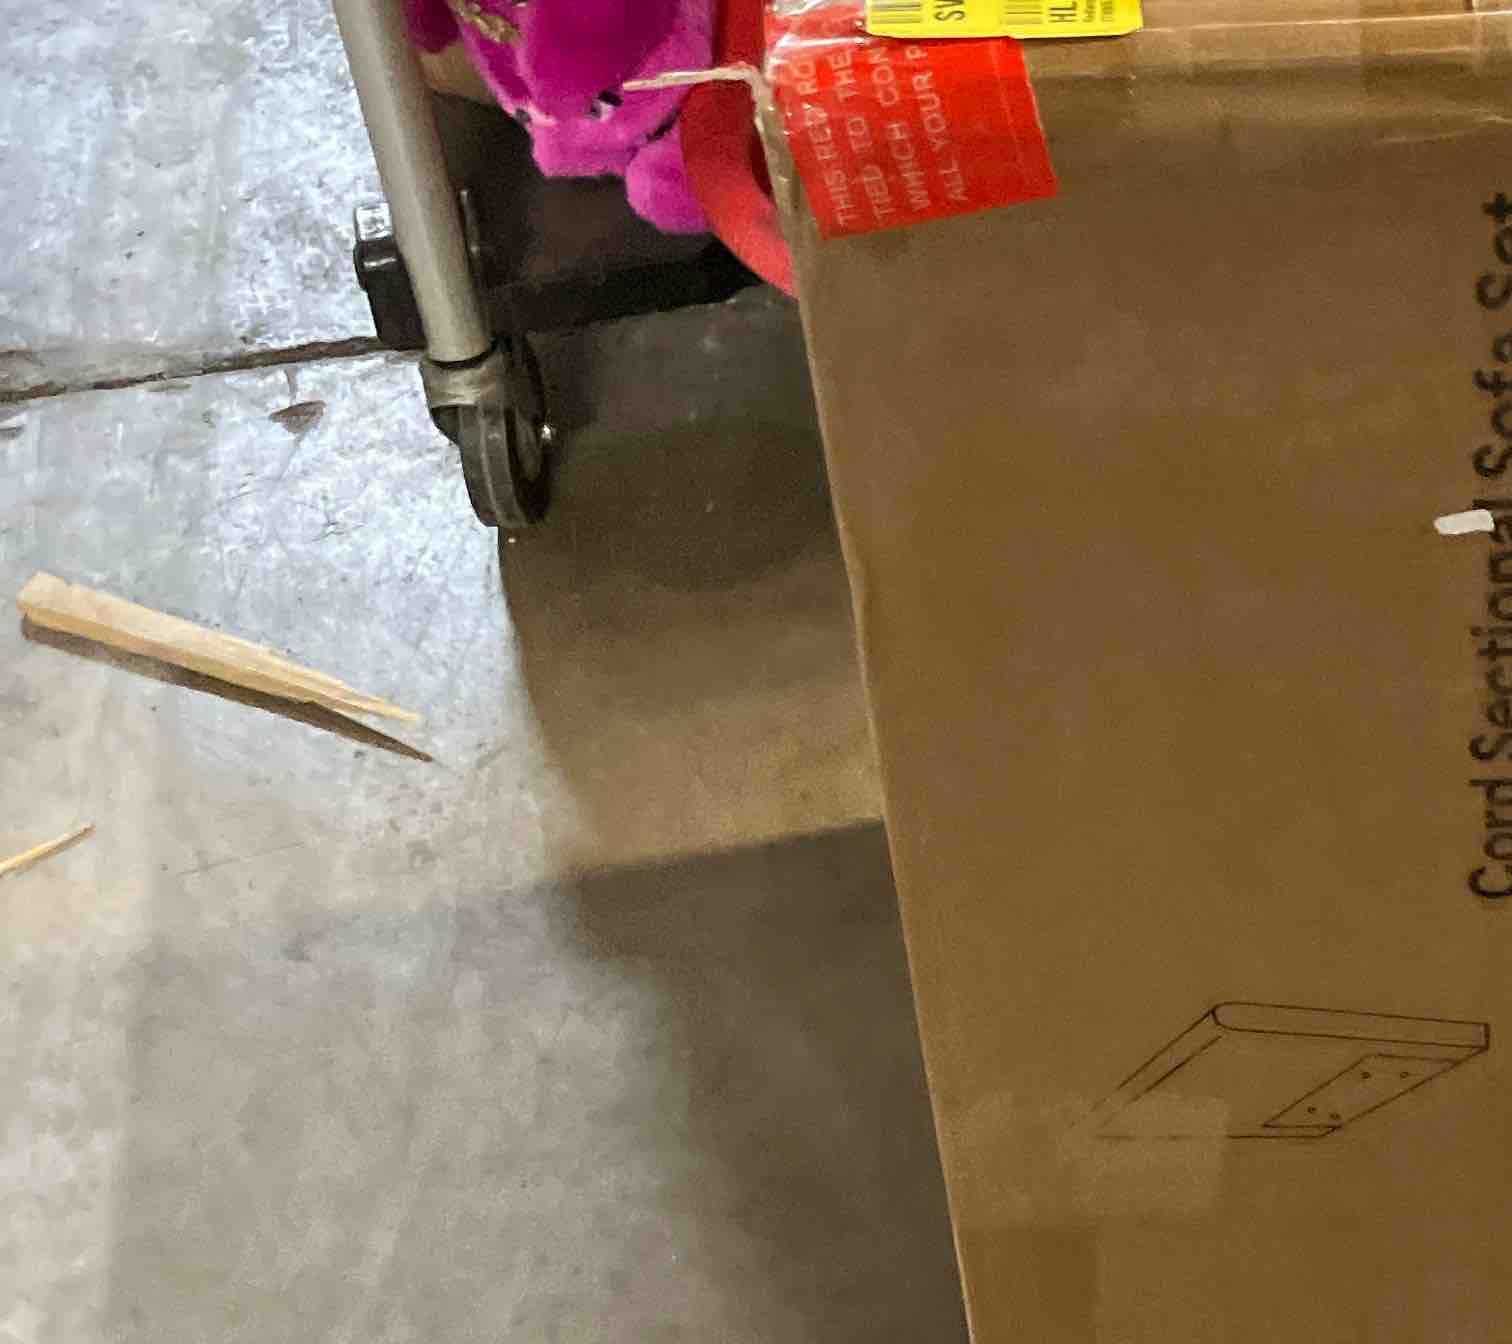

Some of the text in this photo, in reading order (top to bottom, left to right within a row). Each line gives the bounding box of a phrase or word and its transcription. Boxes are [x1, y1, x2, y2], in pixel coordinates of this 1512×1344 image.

[846, 116, 873, 155] TO
[911, 69, 951, 154] YOUR
[862, 163, 897, 227] TIED
[884, 120, 932, 213] WHICH
[937, 159, 970, 202] ALL
[826, 168, 861, 227] THIS
